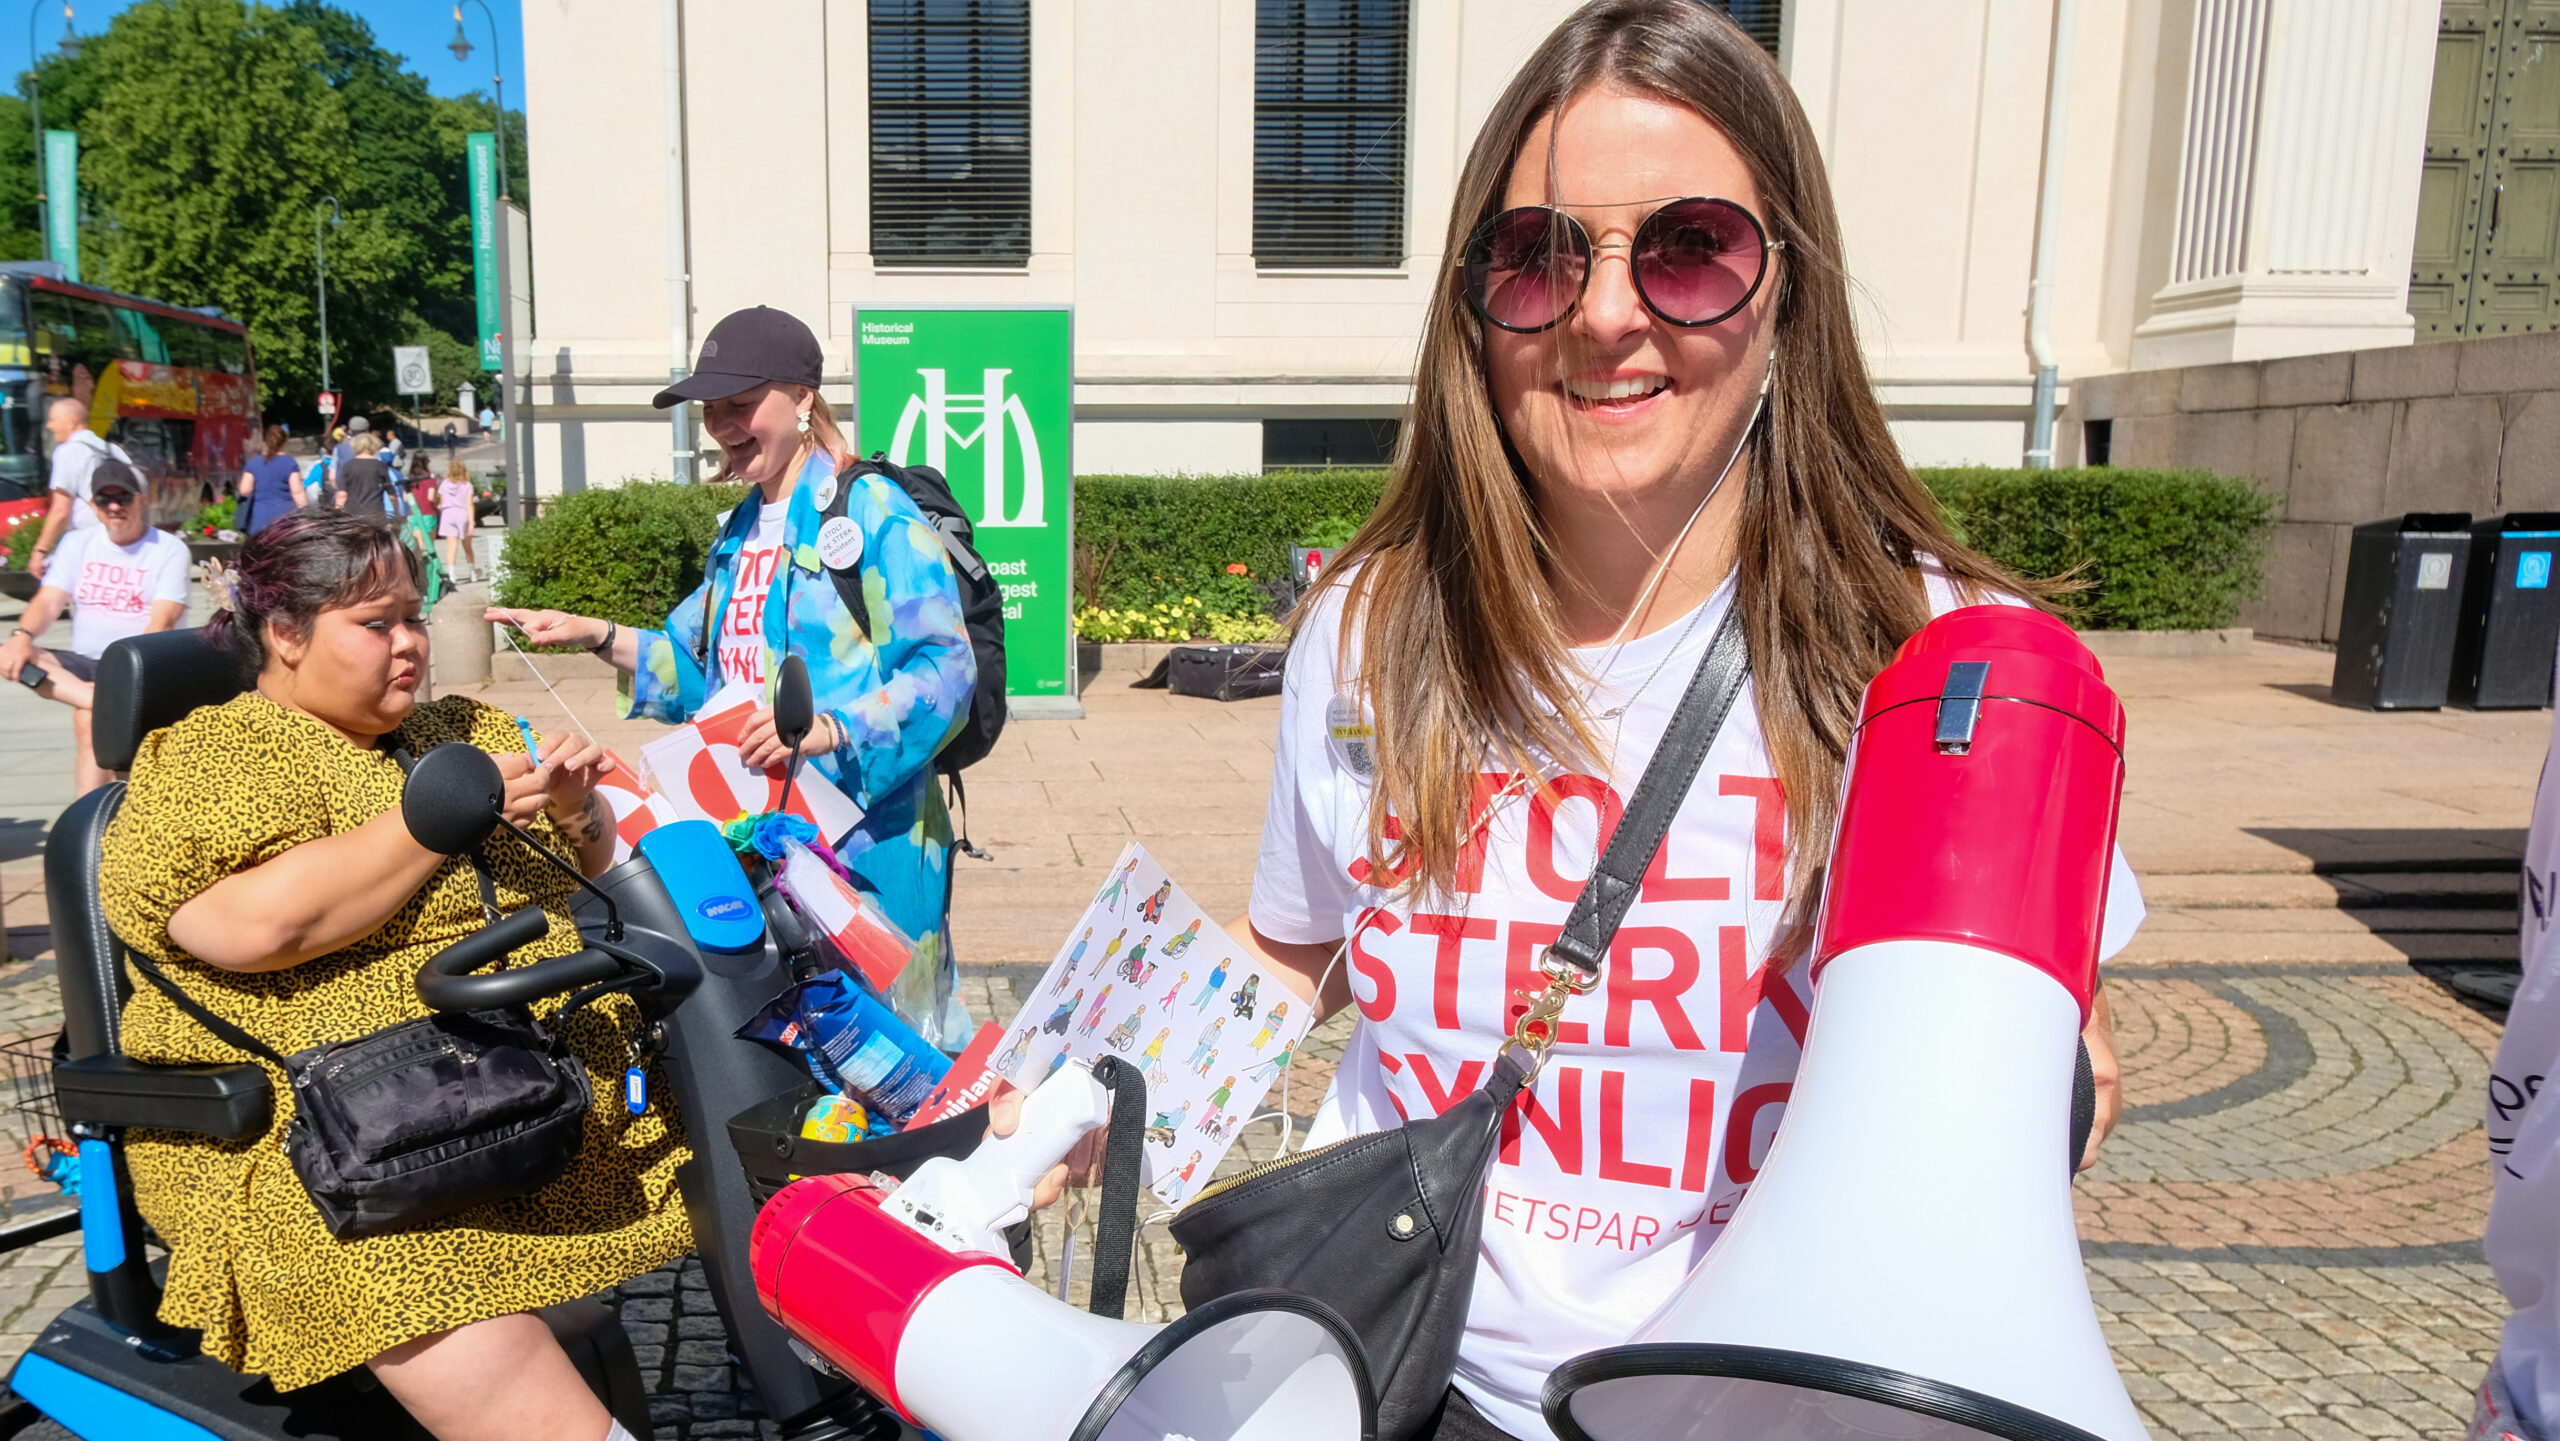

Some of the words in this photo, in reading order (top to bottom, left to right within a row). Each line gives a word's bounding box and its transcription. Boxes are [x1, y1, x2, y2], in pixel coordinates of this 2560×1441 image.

[476, 144, 491, 249] Nasjonalmuseet
[862, 322, 914, 333] Historical
[862, 334, 910, 345] Museum
[824, 523, 844, 539] STOLT
[84, 562, 148, 587] STOLT
[78, 583, 145, 607] STERK
[998, 581, 1038, 602] gest
[1001, 602, 1022, 619] cal
[718, 646, 765, 684] YNL
[1351, 905, 1816, 1054] STERK
